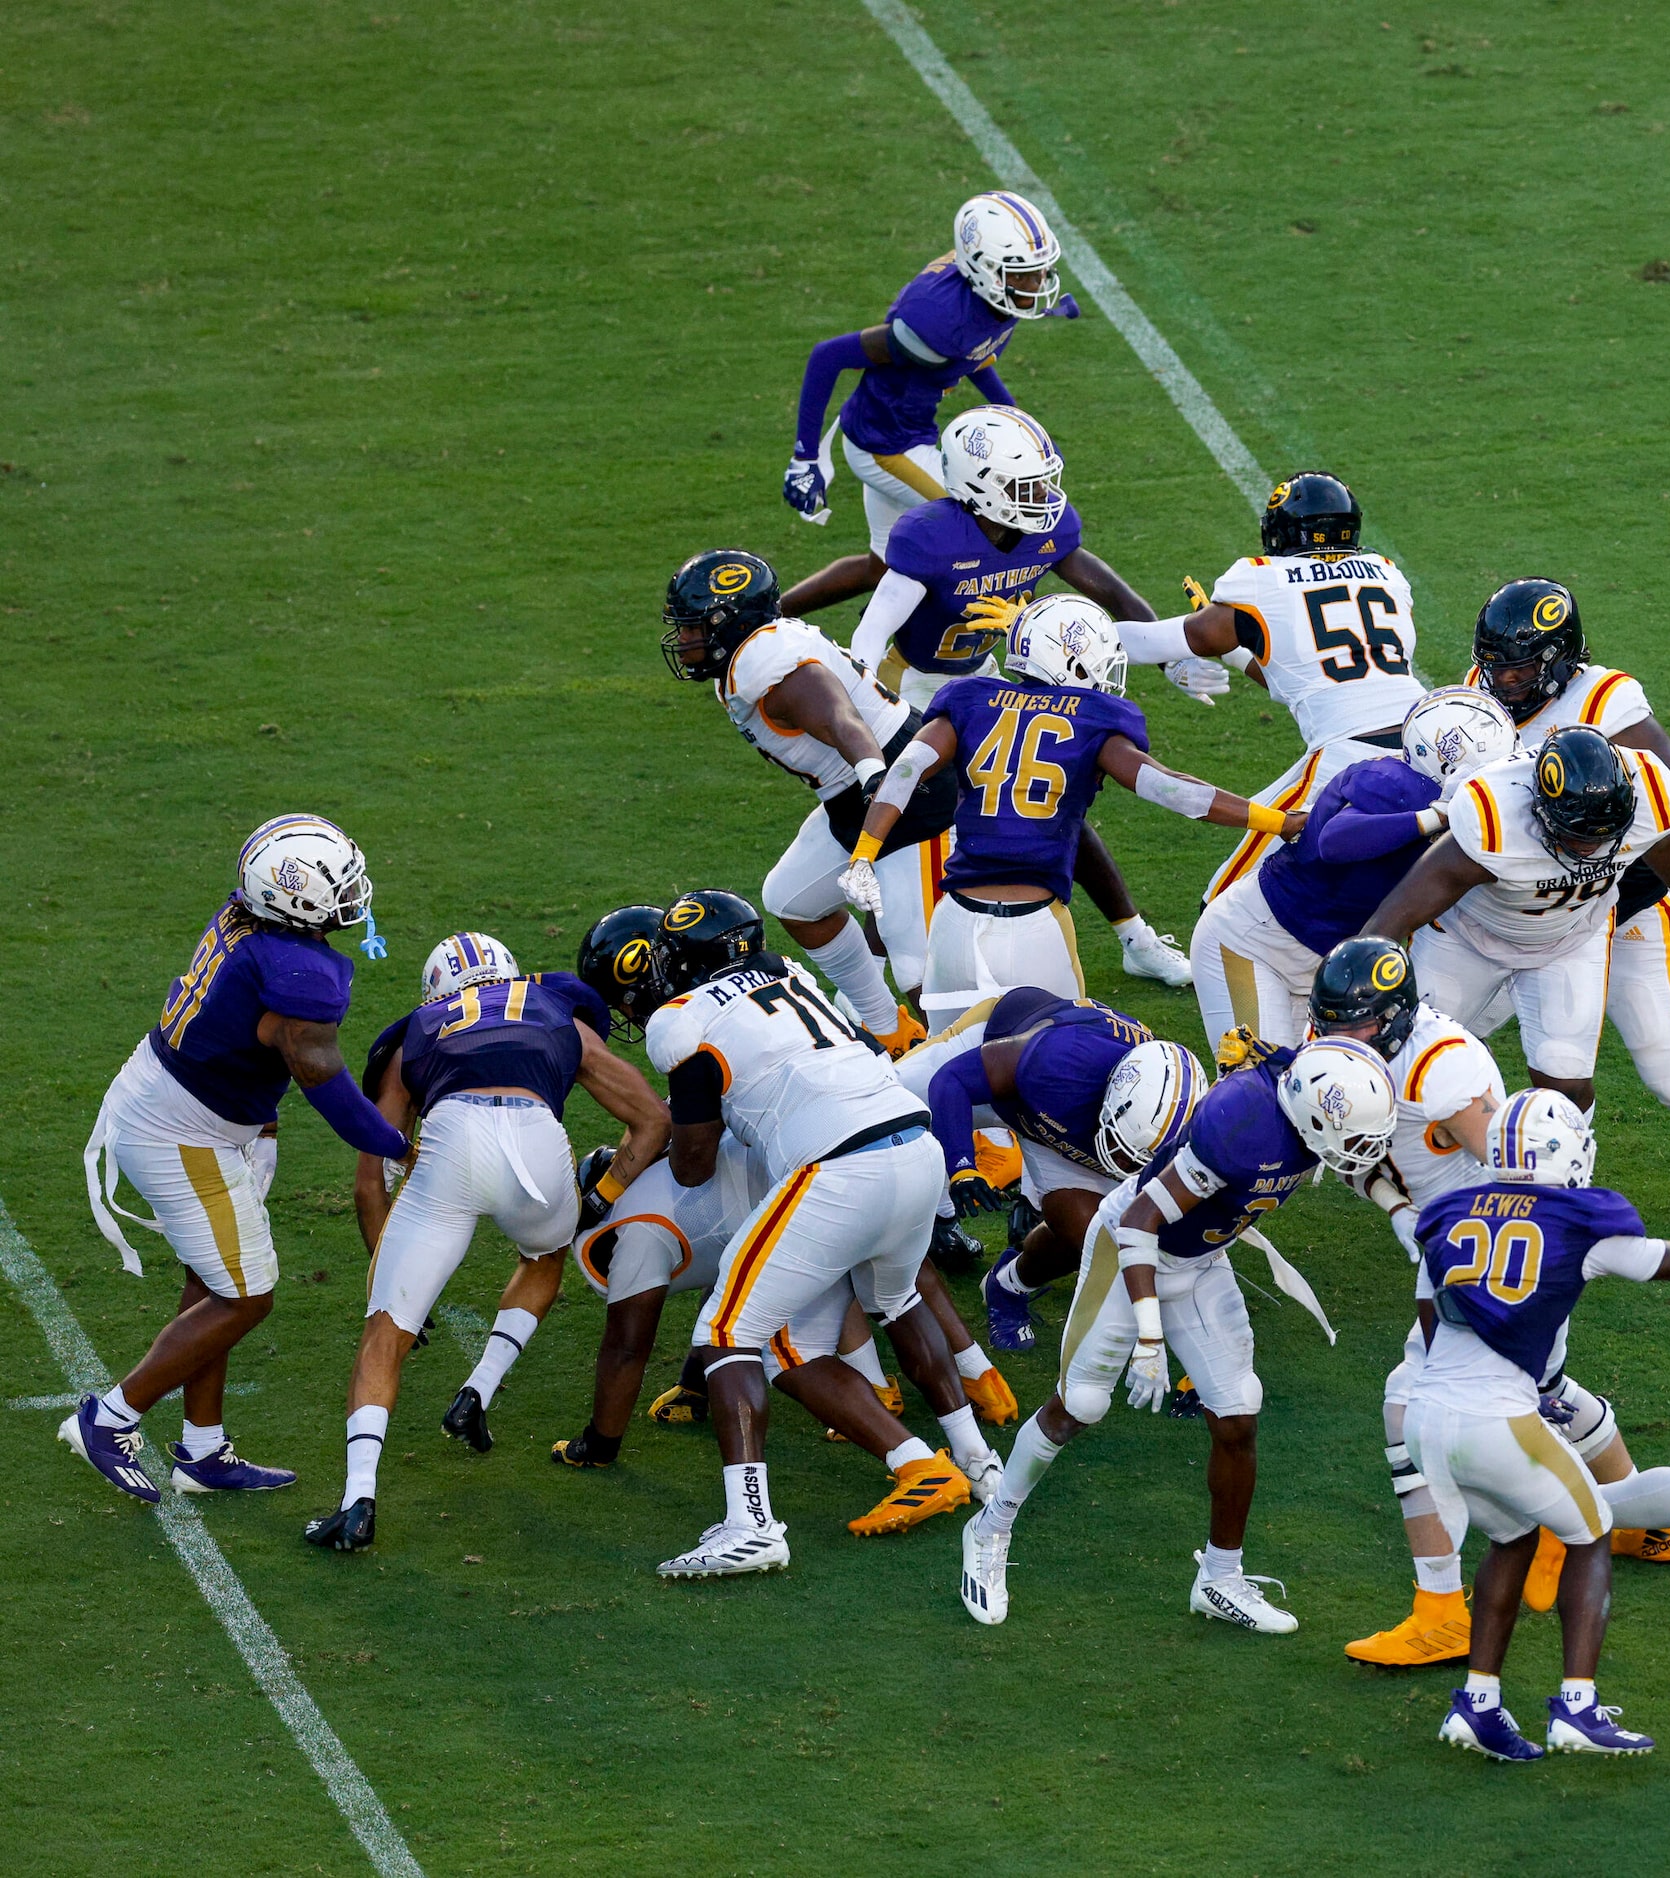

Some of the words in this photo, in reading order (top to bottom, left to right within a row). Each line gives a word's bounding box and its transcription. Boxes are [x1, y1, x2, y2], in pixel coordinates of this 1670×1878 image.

[1302, 584, 1410, 684] 56
[966, 707, 1075, 820] 46
[160, 926, 226, 1052] 91
[748, 975, 858, 1050] 71
[1469, 1192, 1537, 1217] LEWIS
[1443, 1218, 1544, 1305] 20
